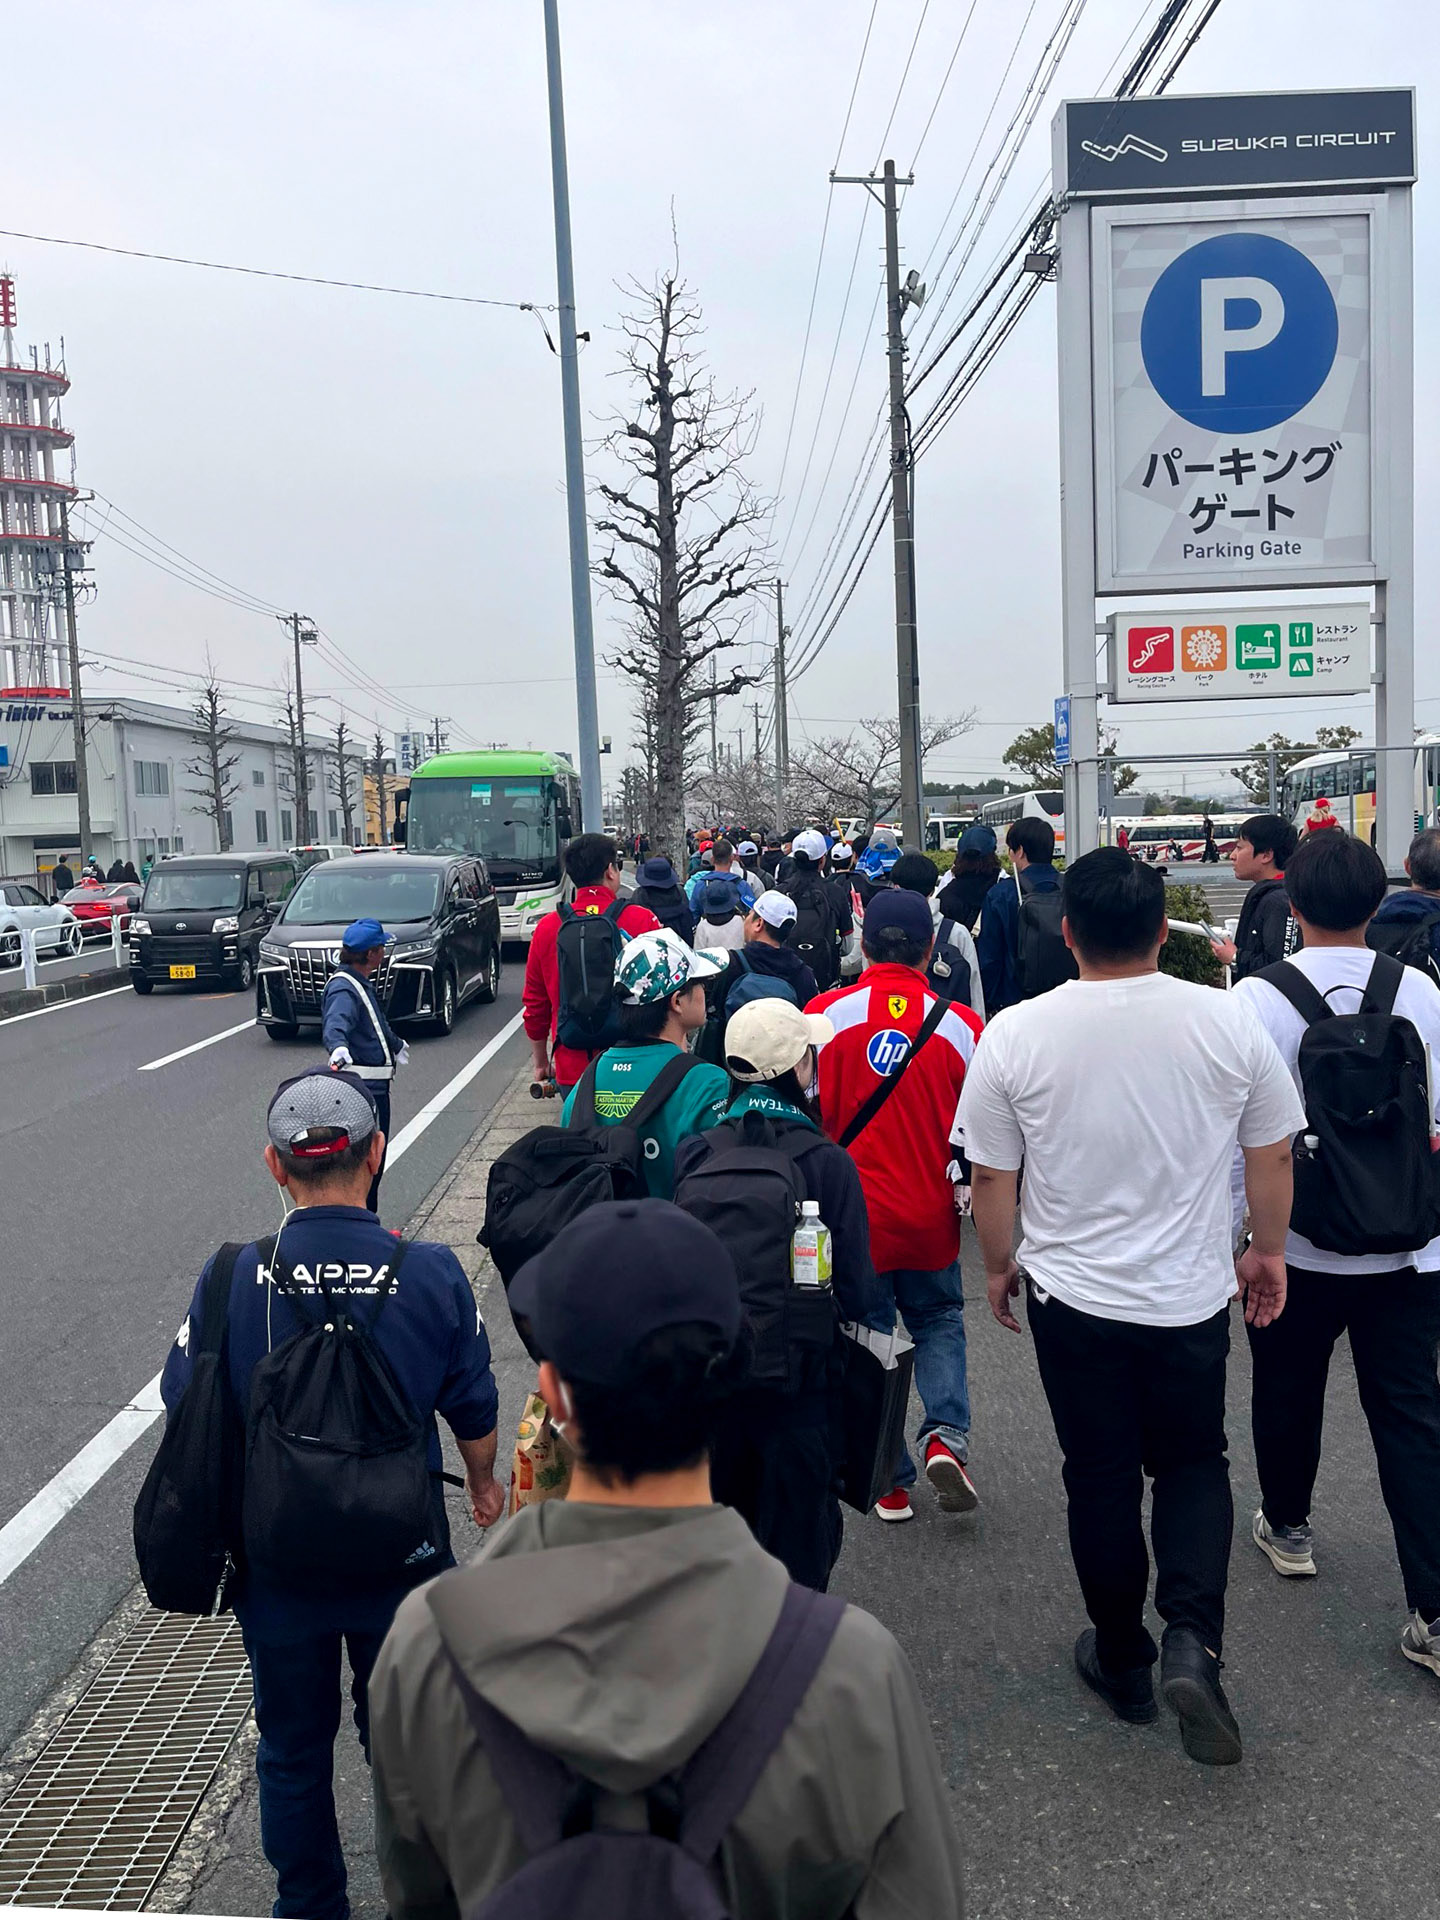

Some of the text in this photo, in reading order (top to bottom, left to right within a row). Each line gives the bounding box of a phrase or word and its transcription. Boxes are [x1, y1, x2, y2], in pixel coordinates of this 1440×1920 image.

[1181, 131, 1396, 152] SUZUKA CIRCUIT
[1200, 276, 1285, 397] P
[1142, 440, 1343, 488] パーキング
[1188, 493, 1295, 535] ゲート
[1183, 540, 1302, 560] Parking Gate
[1316, 625, 1358, 635] レストラン
[1316, 655, 1351, 665] キャンプ
[1128, 675, 1176, 684] レーシングコース
[1248, 672, 1268, 680] ホテル
[612, 1063, 632, 1072] BOSS
[749, 1097, 784, 1112] TEAM
